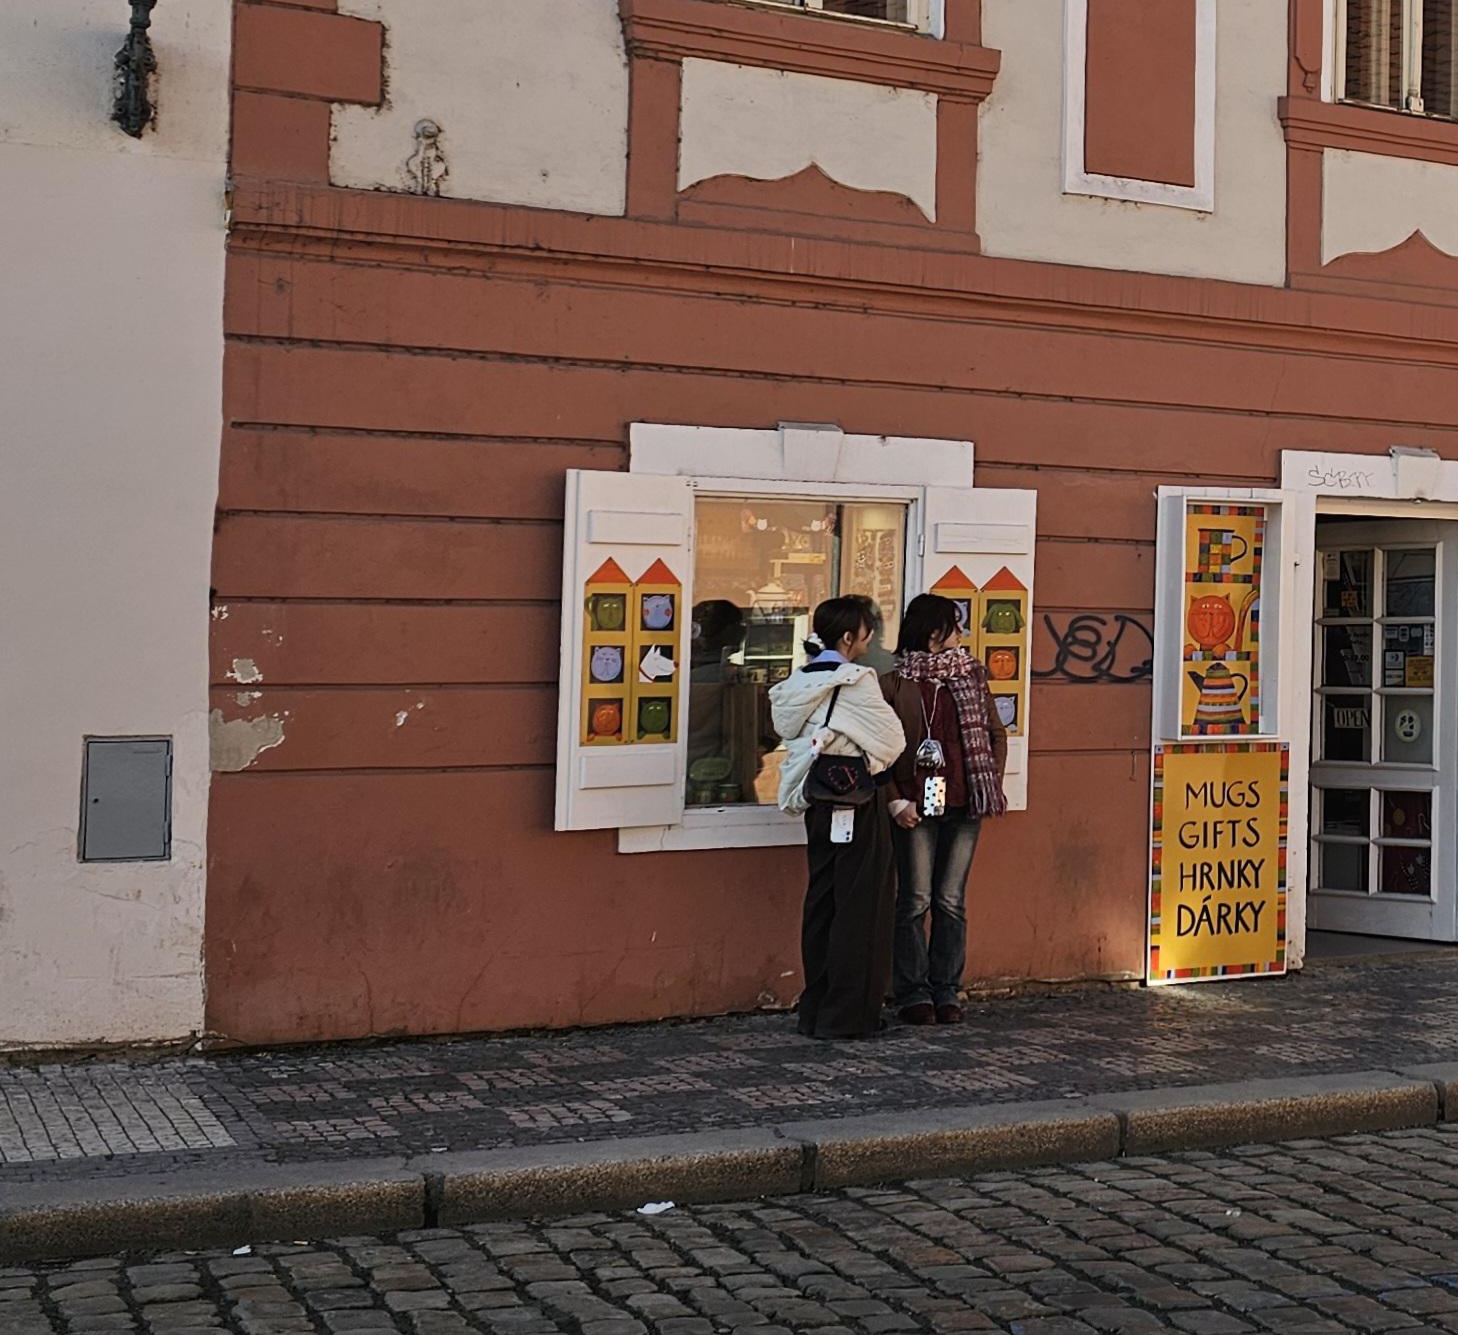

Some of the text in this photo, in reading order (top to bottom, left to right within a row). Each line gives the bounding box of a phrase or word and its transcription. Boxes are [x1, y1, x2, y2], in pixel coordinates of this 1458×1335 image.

[1336, 709, 1370, 728] OPEN
[1185, 780, 1261, 810] MUGS
[1178, 817, 1260, 850] GIFTS
[1179, 858, 1265, 892] HRNKY
[1176, 894, 1266, 937] DÁRKY
